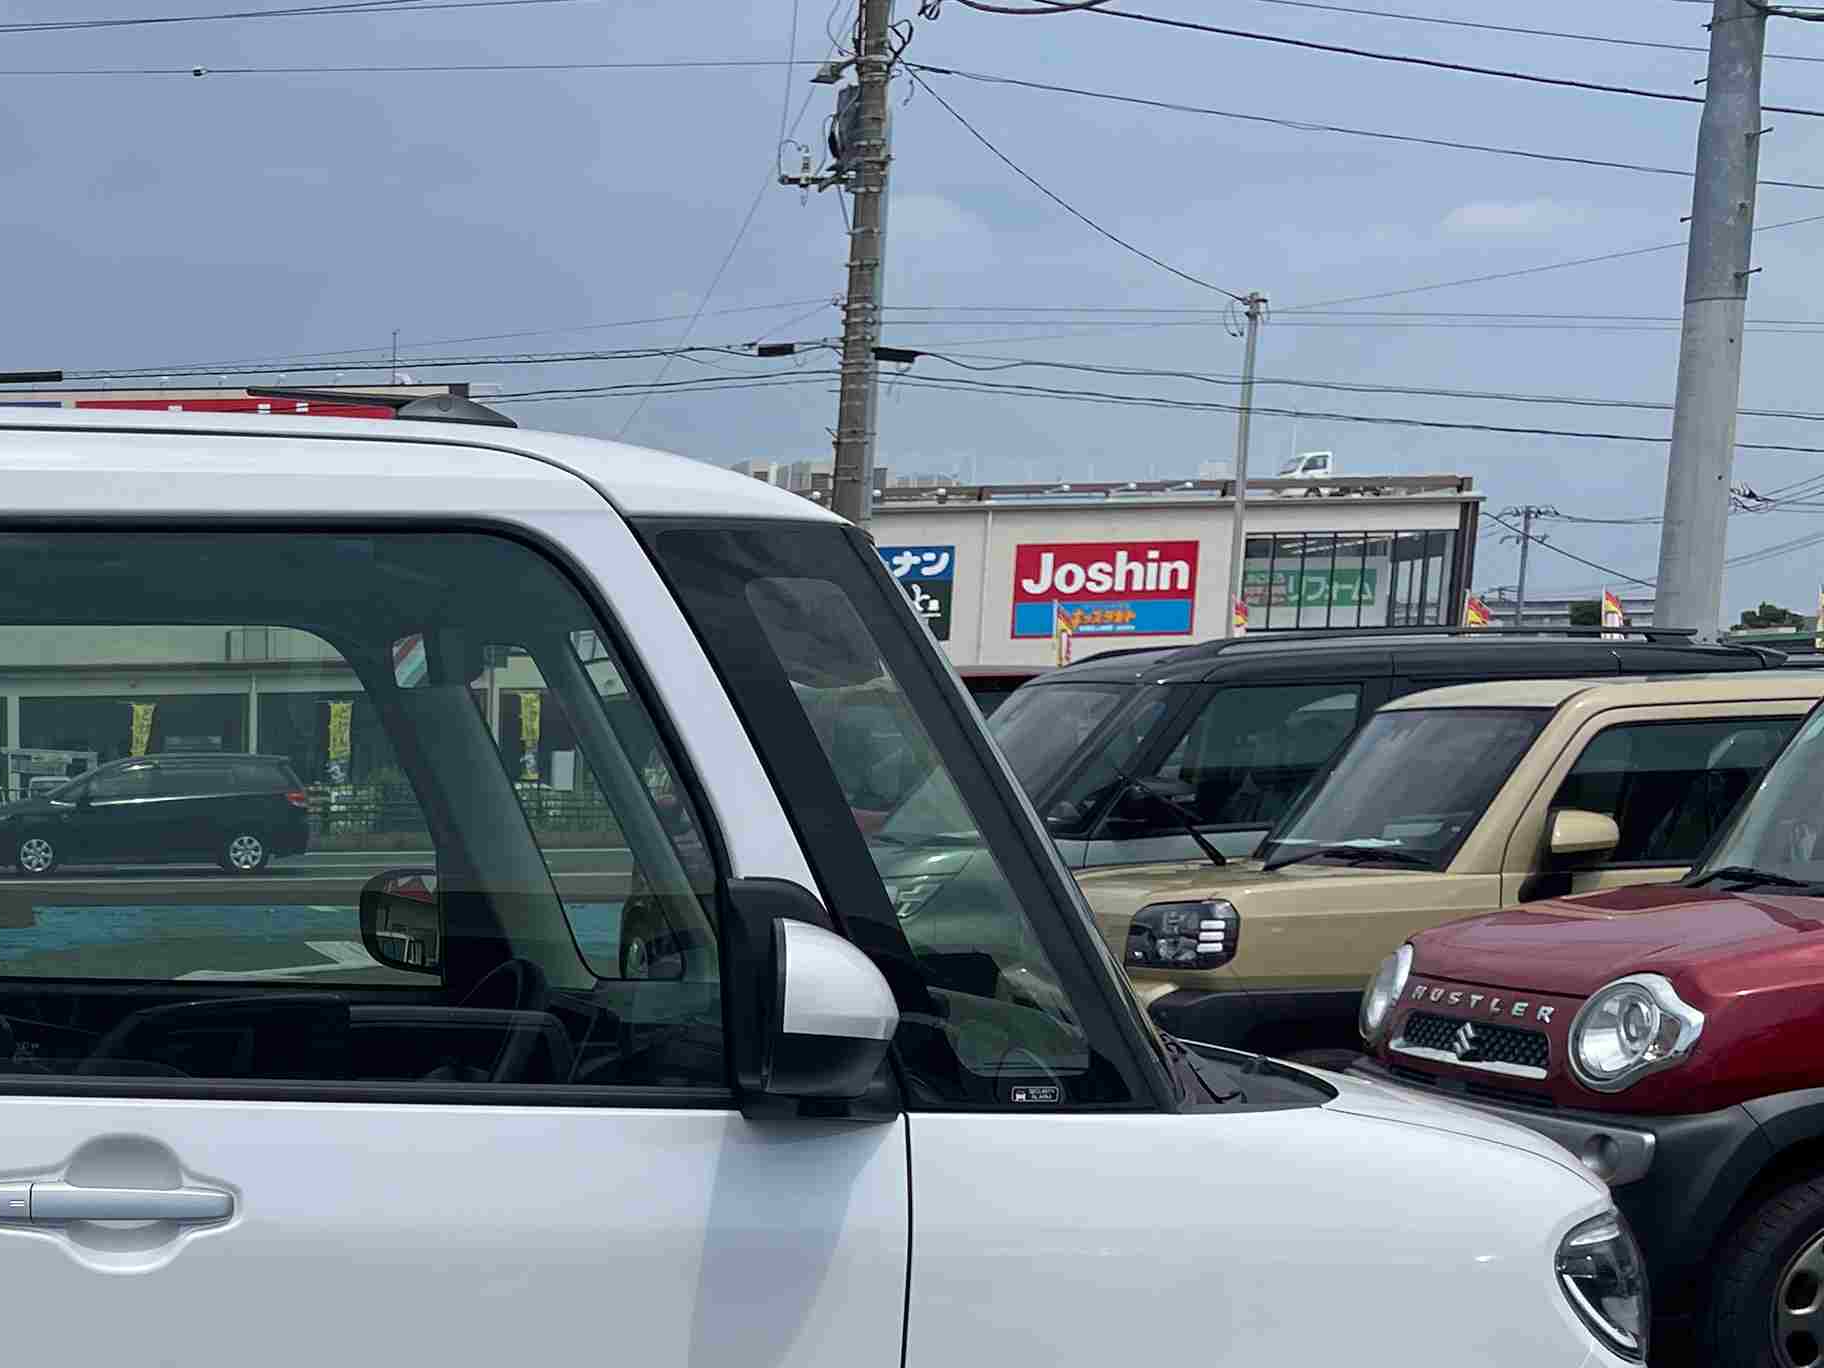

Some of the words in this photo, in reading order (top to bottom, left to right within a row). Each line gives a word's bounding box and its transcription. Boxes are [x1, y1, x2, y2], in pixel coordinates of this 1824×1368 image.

[889, 550, 950, 577] ナン
[1021, 550, 1190, 594] Joshin
[1412, 985, 1555, 1024] HUSTLER
